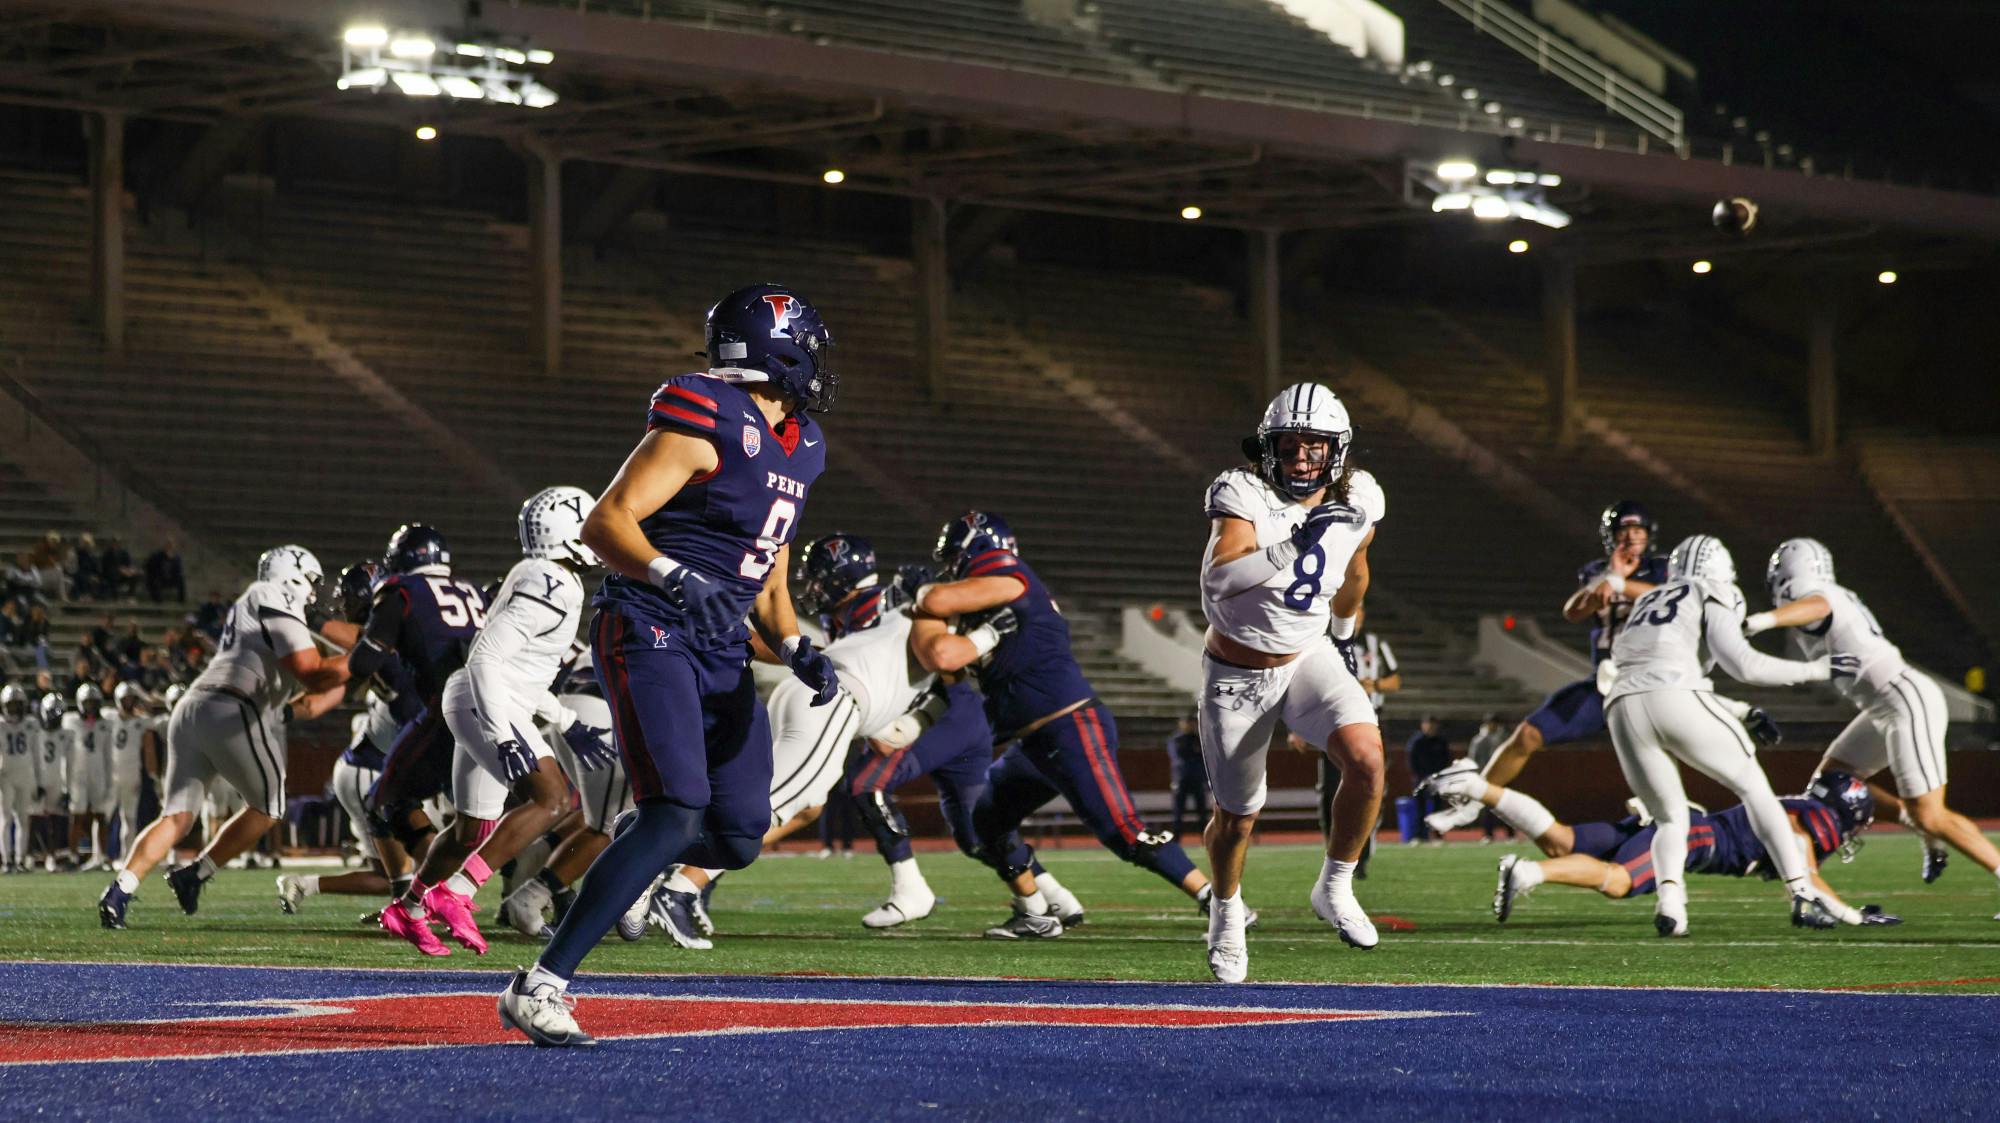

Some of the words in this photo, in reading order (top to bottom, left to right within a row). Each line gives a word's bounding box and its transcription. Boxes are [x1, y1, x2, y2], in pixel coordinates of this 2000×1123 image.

[763, 294, 803, 339] P
[1290, 421, 1313, 430] YALE
[767, 471, 805, 498] PENN
[559, 496, 585, 523] Y
[738, 498, 796, 580] 9
[290, 550, 304, 570] Y
[542, 573, 564, 600] Y
[1284, 543, 1326, 611] 8
[283, 593, 295, 610] Y
[425, 574, 487, 628] 52
[1625, 584, 1690, 630] 23
[650, 626, 674, 648] P
[7, 732, 27, 755] 16
[44, 741, 56, 764] 3
[84, 731, 95, 752] 4
